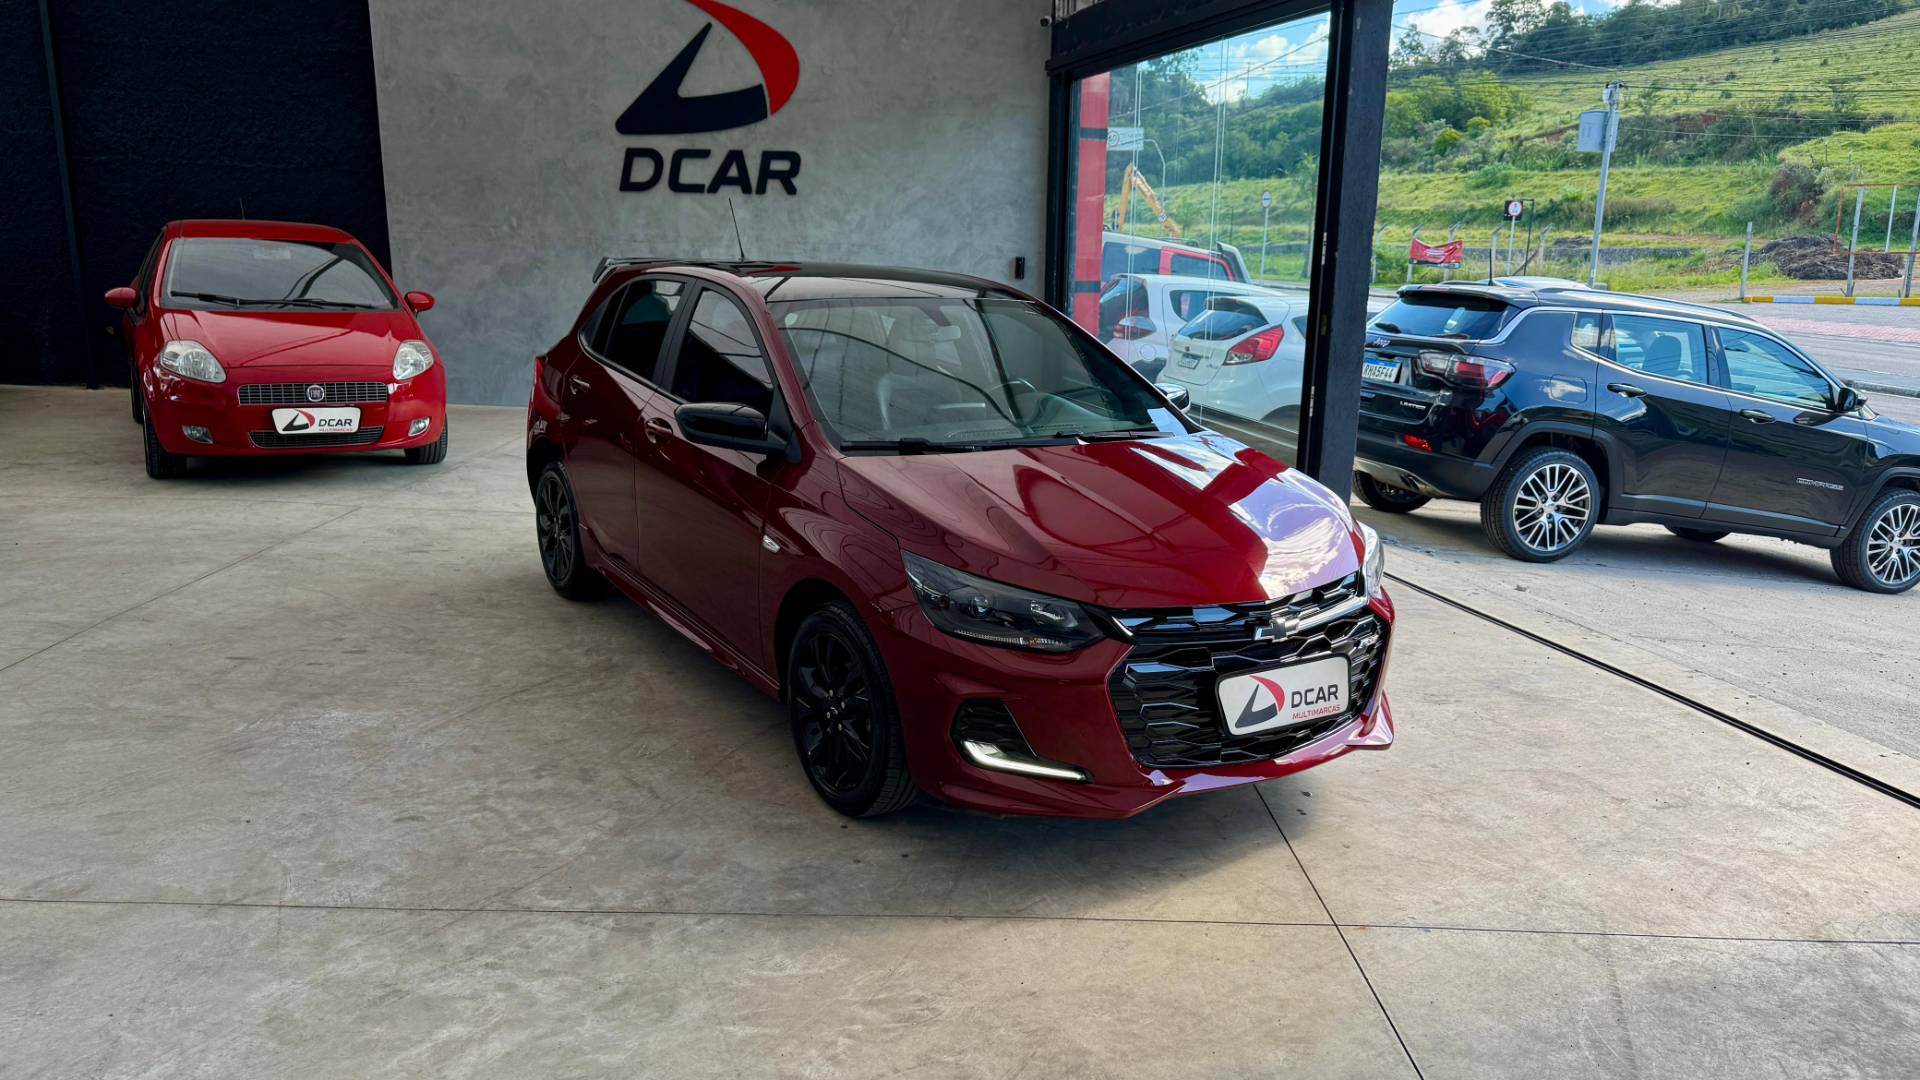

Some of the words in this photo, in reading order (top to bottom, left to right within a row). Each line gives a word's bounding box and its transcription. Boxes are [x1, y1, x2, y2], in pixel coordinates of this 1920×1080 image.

[619, 147, 802, 195] DCAR
[318, 418, 353, 427] DCAR
[1291, 684, 1338, 708] DCAR
[1292, 704, 1342, 720] MULTIMARCAS
